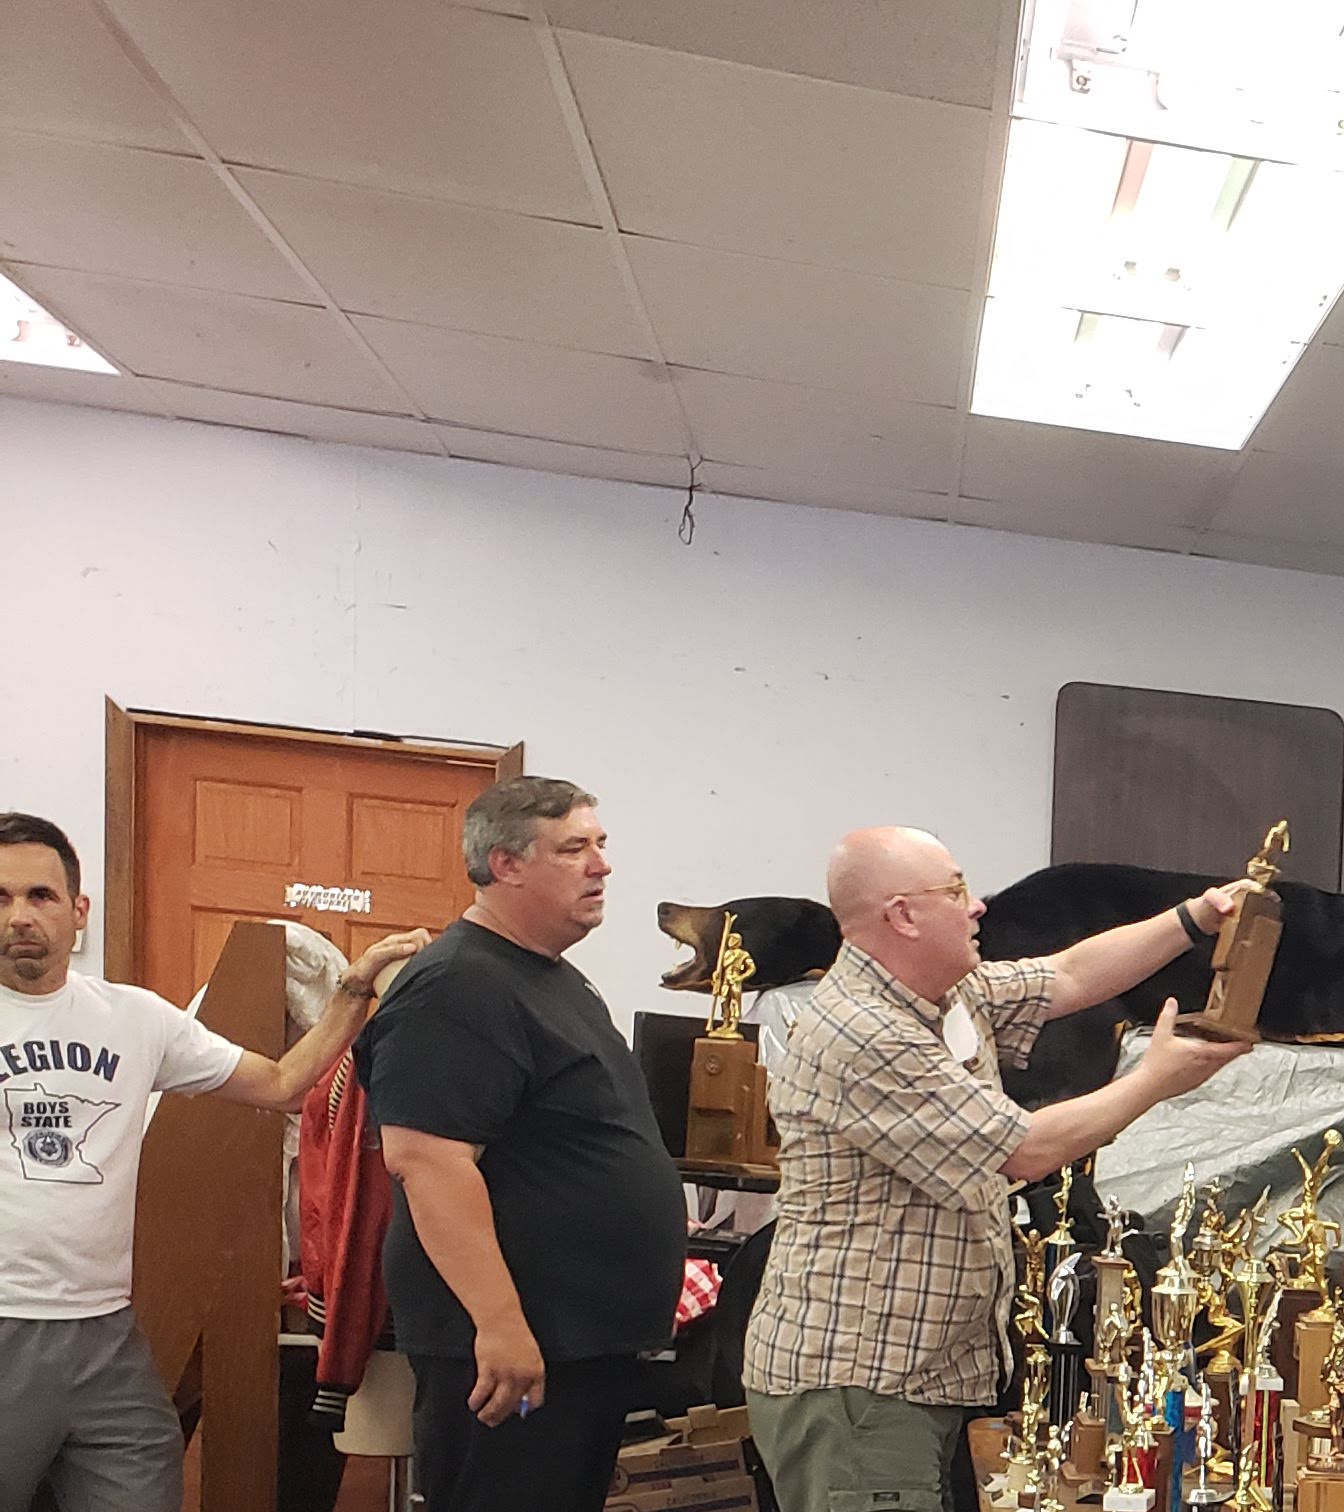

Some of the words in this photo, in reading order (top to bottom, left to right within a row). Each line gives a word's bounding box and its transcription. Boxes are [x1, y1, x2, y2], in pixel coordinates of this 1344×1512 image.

[0, 1040, 120, 1083] EGION
[23, 1101, 70, 1115] BOYS
[20, 1115, 73, 1129] STATE
